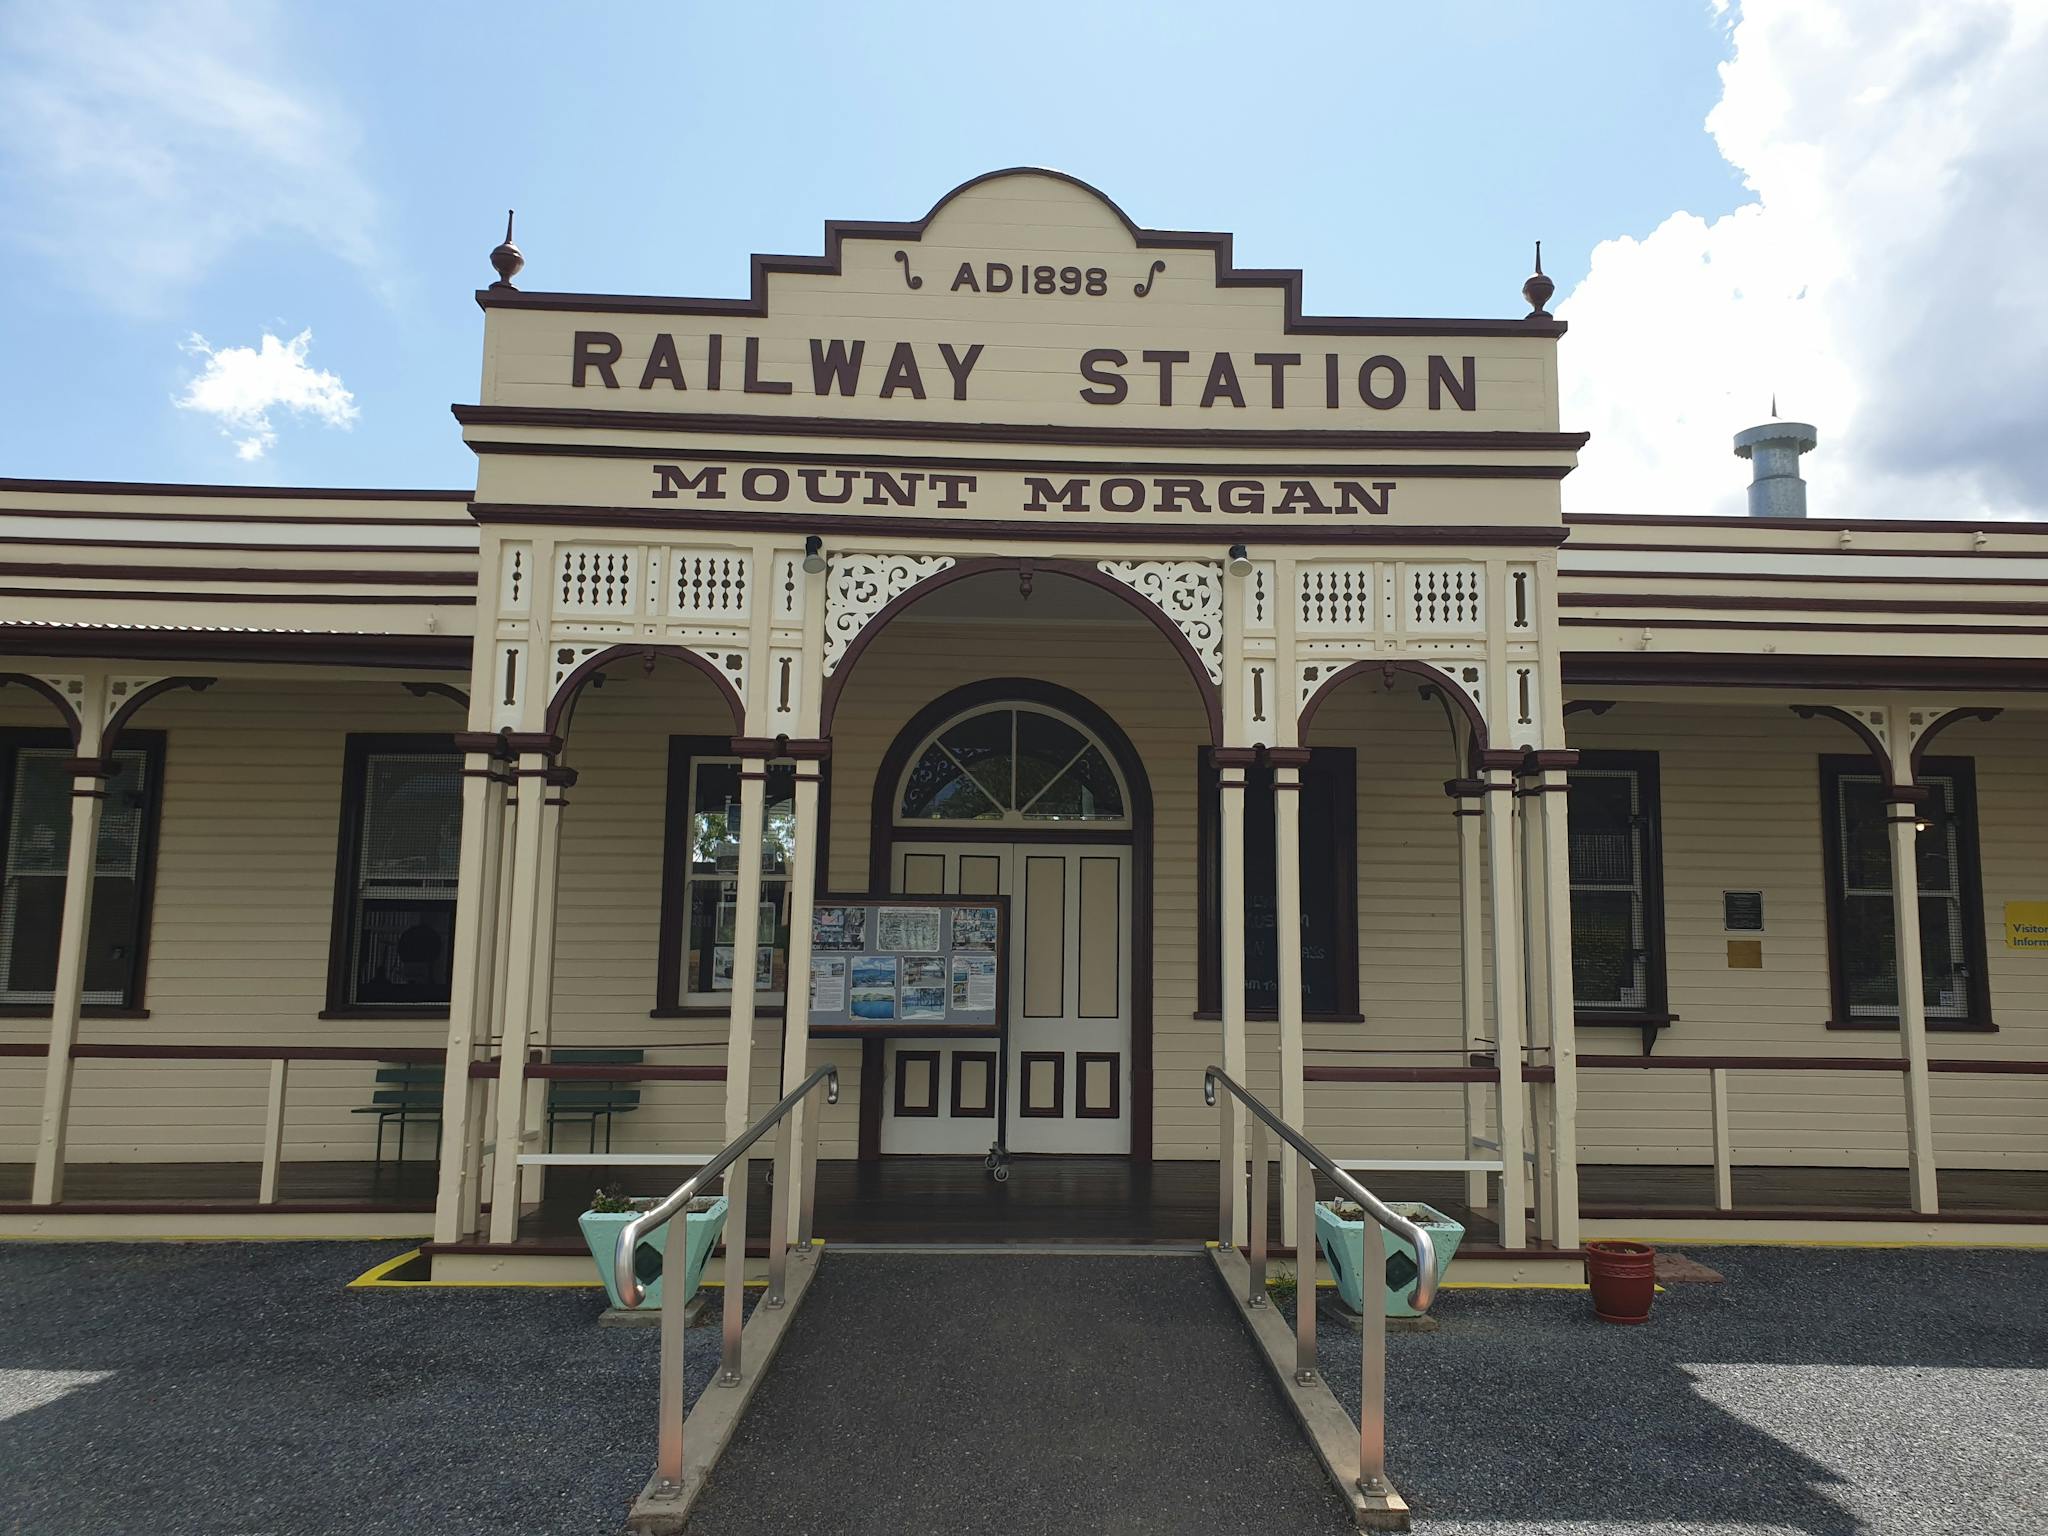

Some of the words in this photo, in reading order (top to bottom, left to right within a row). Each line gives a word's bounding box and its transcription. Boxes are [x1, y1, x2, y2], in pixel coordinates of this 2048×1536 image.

[571, 330, 985, 401] RAILWAY
[1079, 348, 1477, 412] STATION
[652, 464, 978, 510] MOUNT
[1023, 477, 1397, 515] MORGAN
